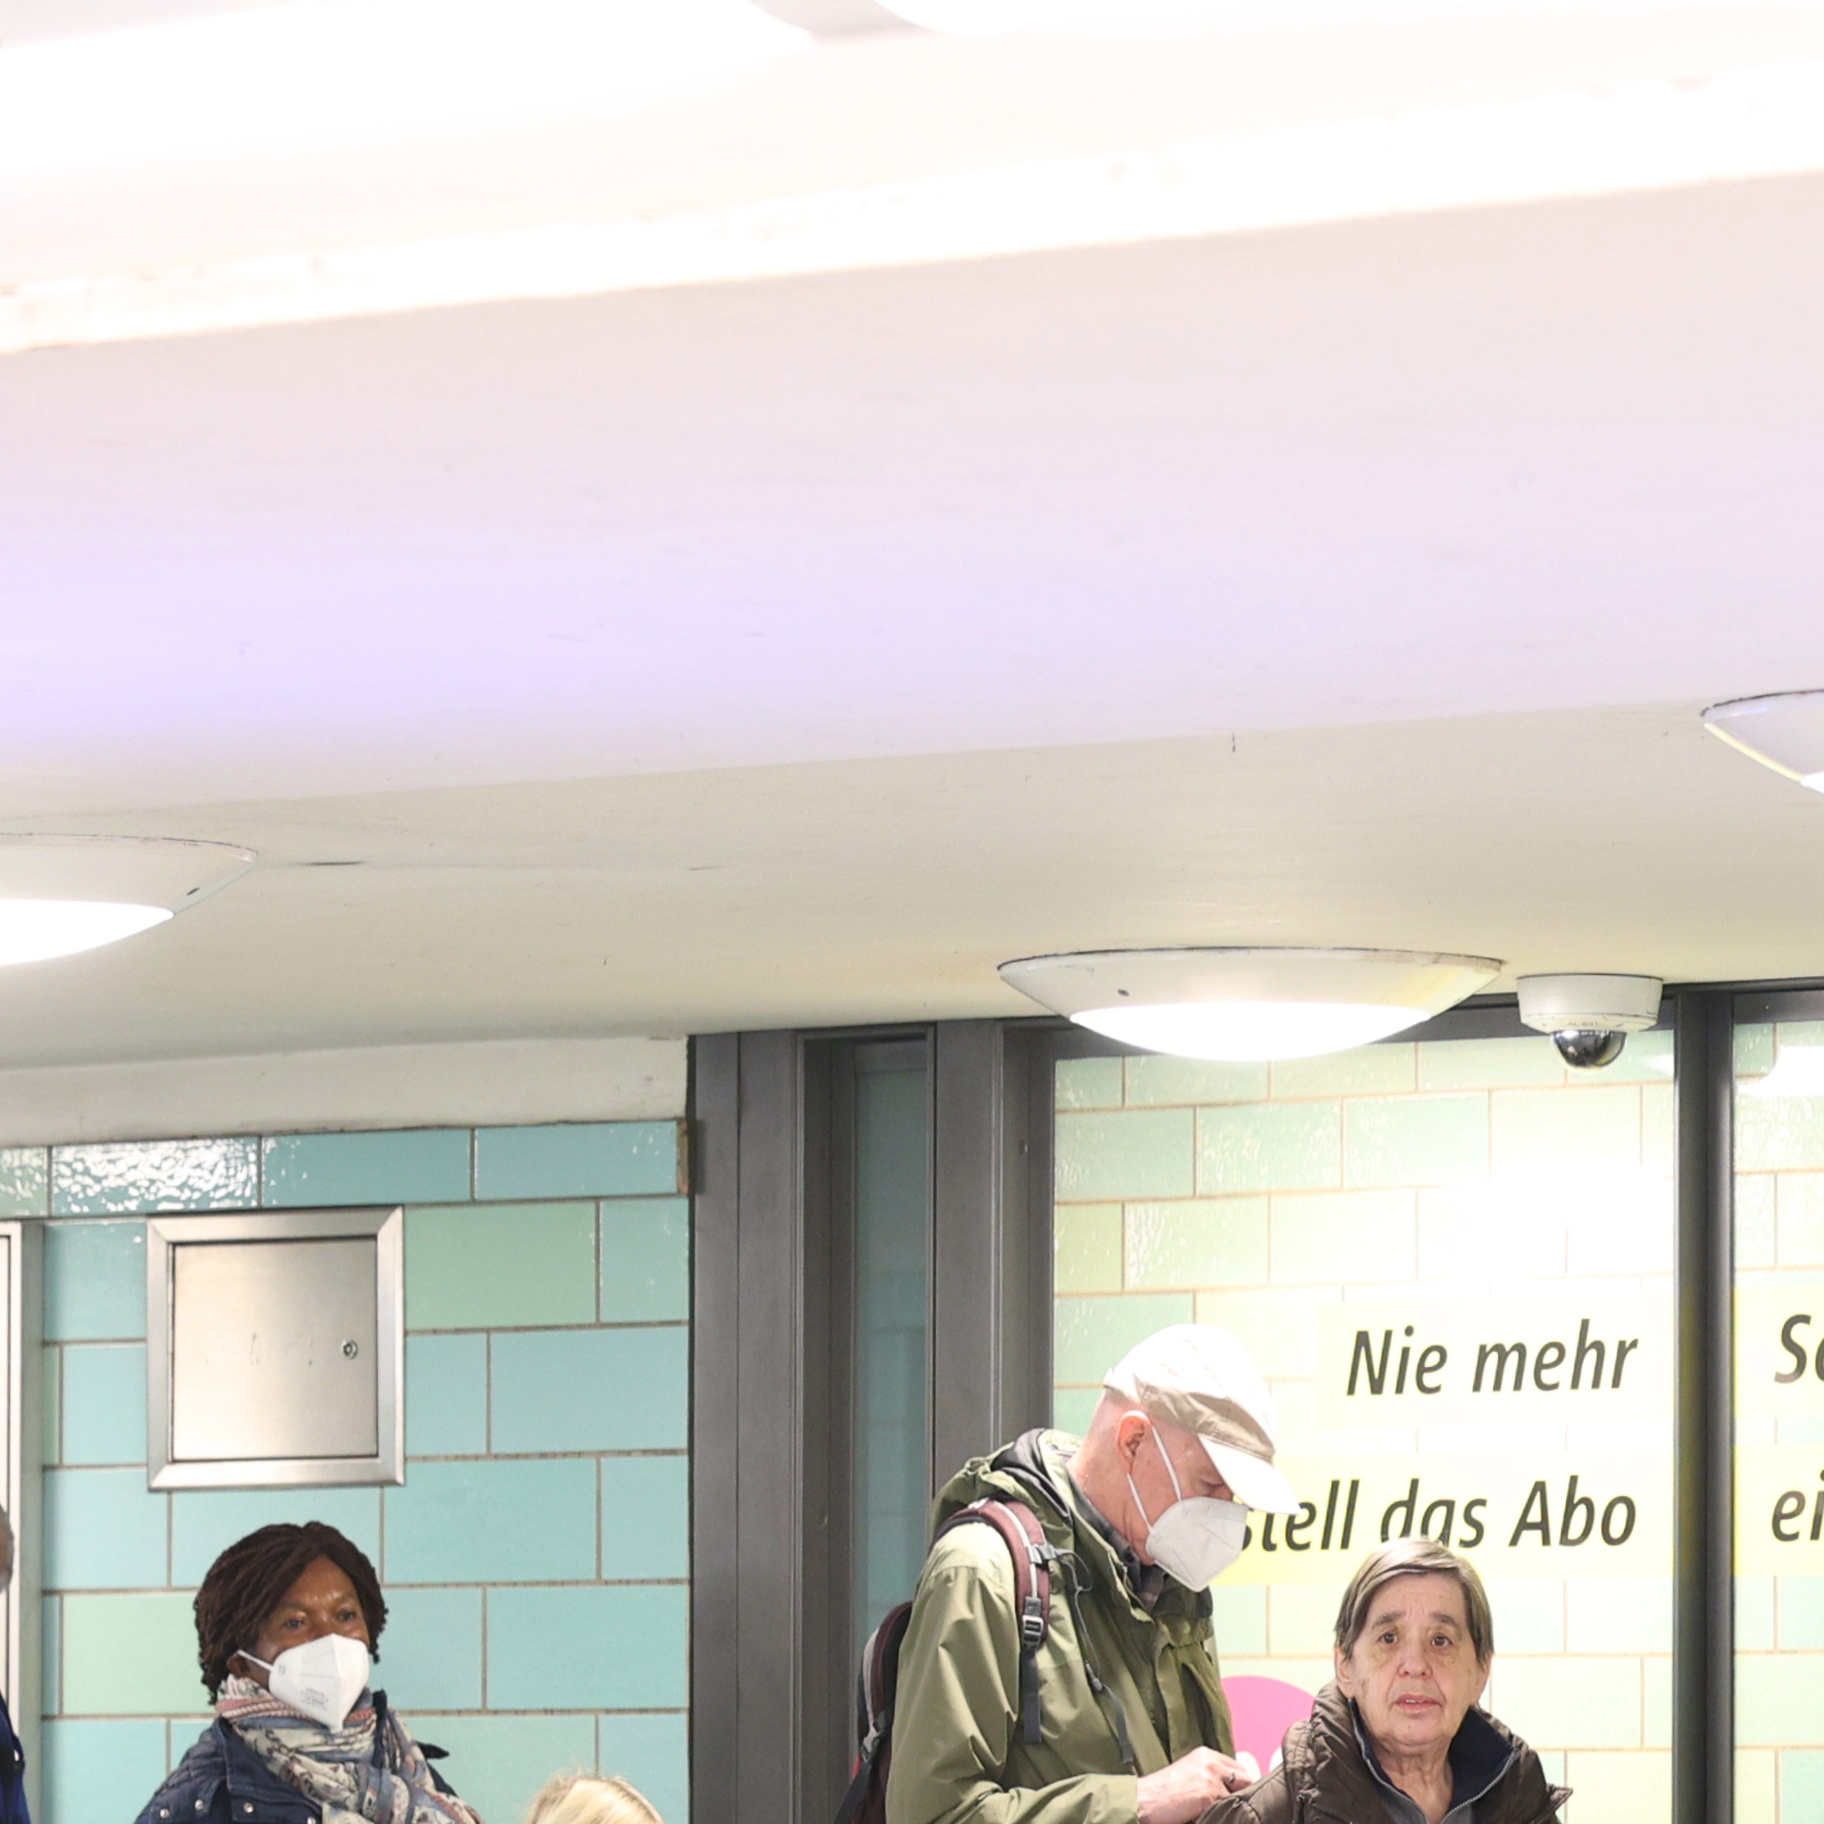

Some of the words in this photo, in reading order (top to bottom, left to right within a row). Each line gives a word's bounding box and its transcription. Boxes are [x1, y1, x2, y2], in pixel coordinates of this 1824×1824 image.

[1346, 1324, 1448, 1396] Nie
[1472, 1317, 1639, 1393] mehr
[1380, 1477, 1488, 1549] das
[1508, 1474, 1637, 1548] Abo
